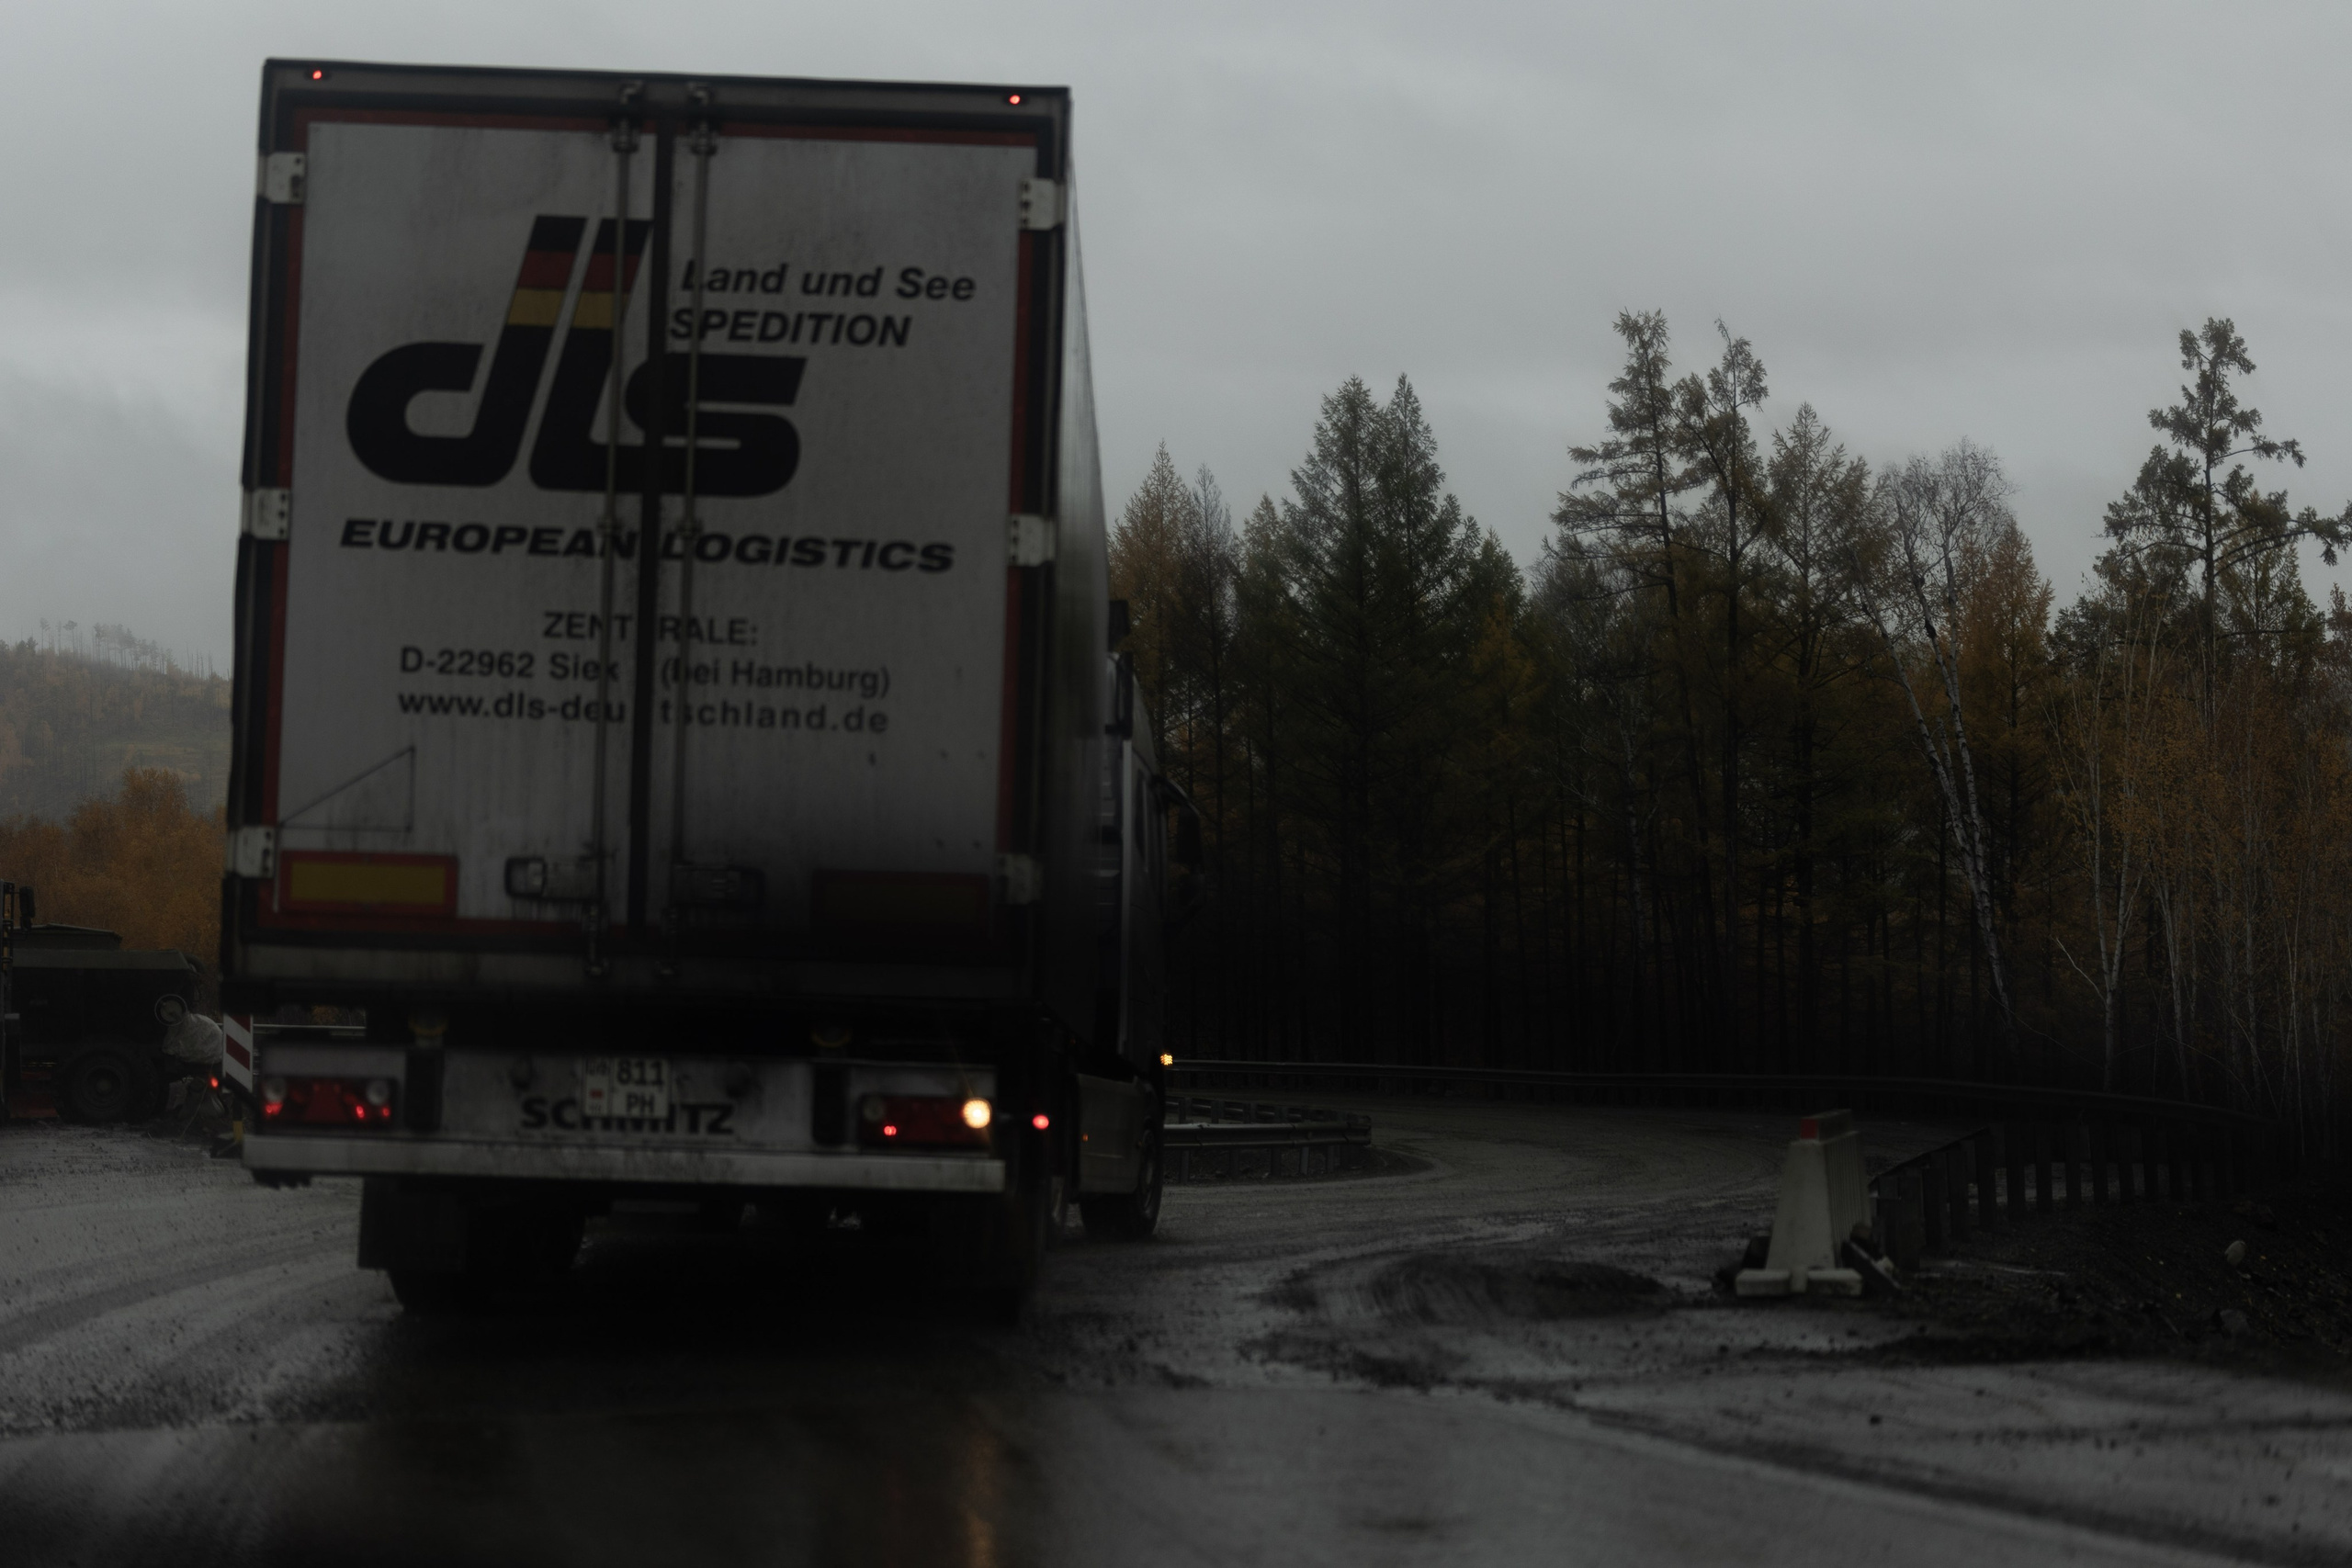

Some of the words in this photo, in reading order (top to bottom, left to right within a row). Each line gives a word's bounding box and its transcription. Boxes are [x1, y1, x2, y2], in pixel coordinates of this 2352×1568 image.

[681, 260, 787, 294] Land
[801, 266, 883, 297] und
[896, 267, 976, 300] See
[670, 308, 912, 347] SPEDITION
[340, 519, 639, 559] EUROPEAN
[661, 533, 954, 573] LOGISTICS
[401, 646, 535, 679] D-22962
[730, 660, 889, 698] Hamburg)
